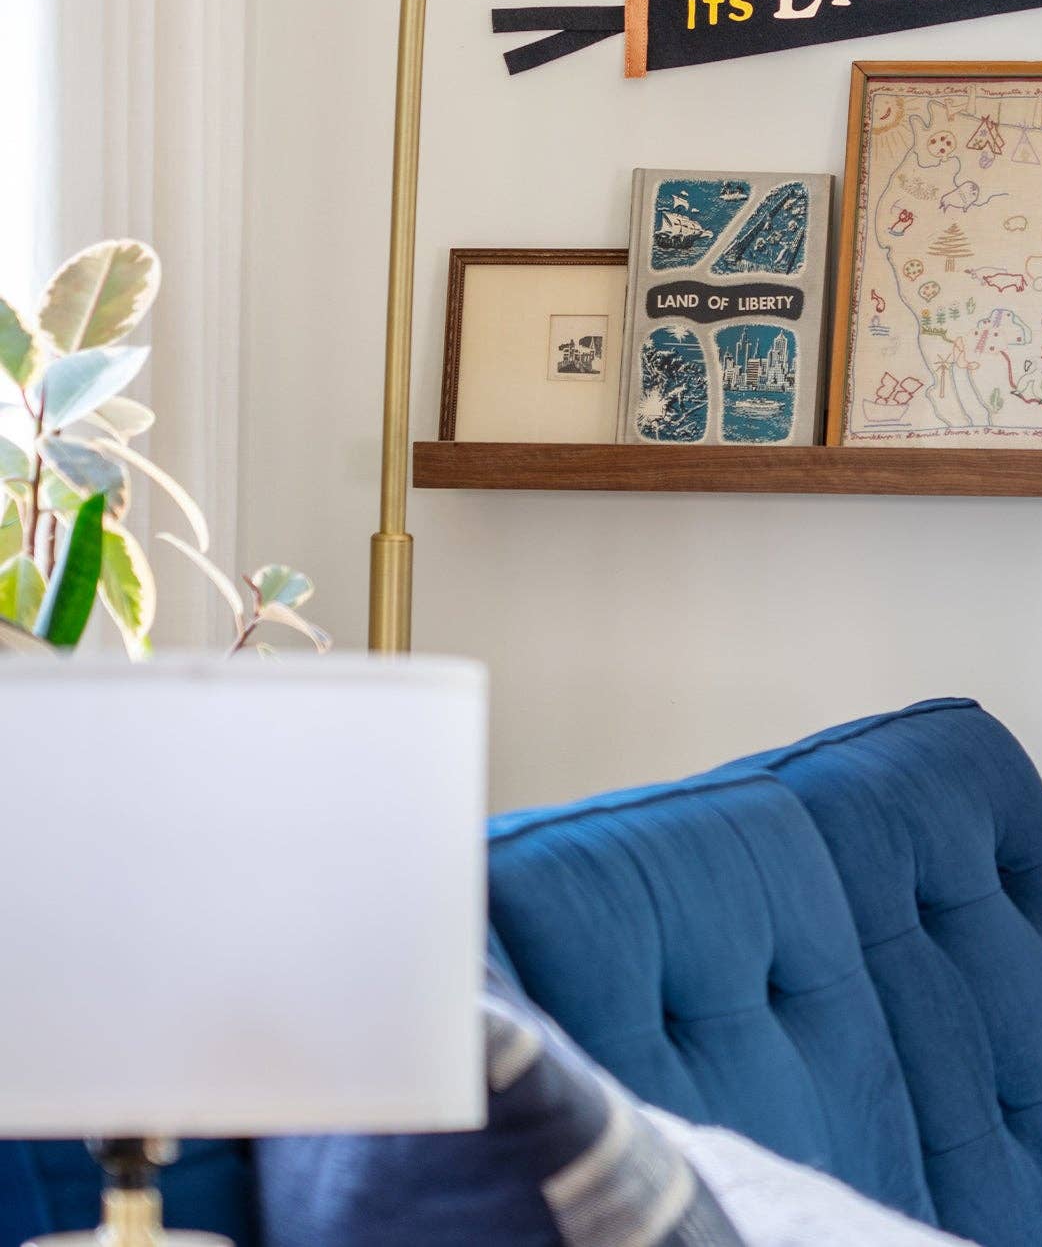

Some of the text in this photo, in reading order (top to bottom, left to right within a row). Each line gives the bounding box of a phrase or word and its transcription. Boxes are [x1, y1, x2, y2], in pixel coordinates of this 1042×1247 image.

[657, 294, 794, 311] LAND OF LIBERTY
